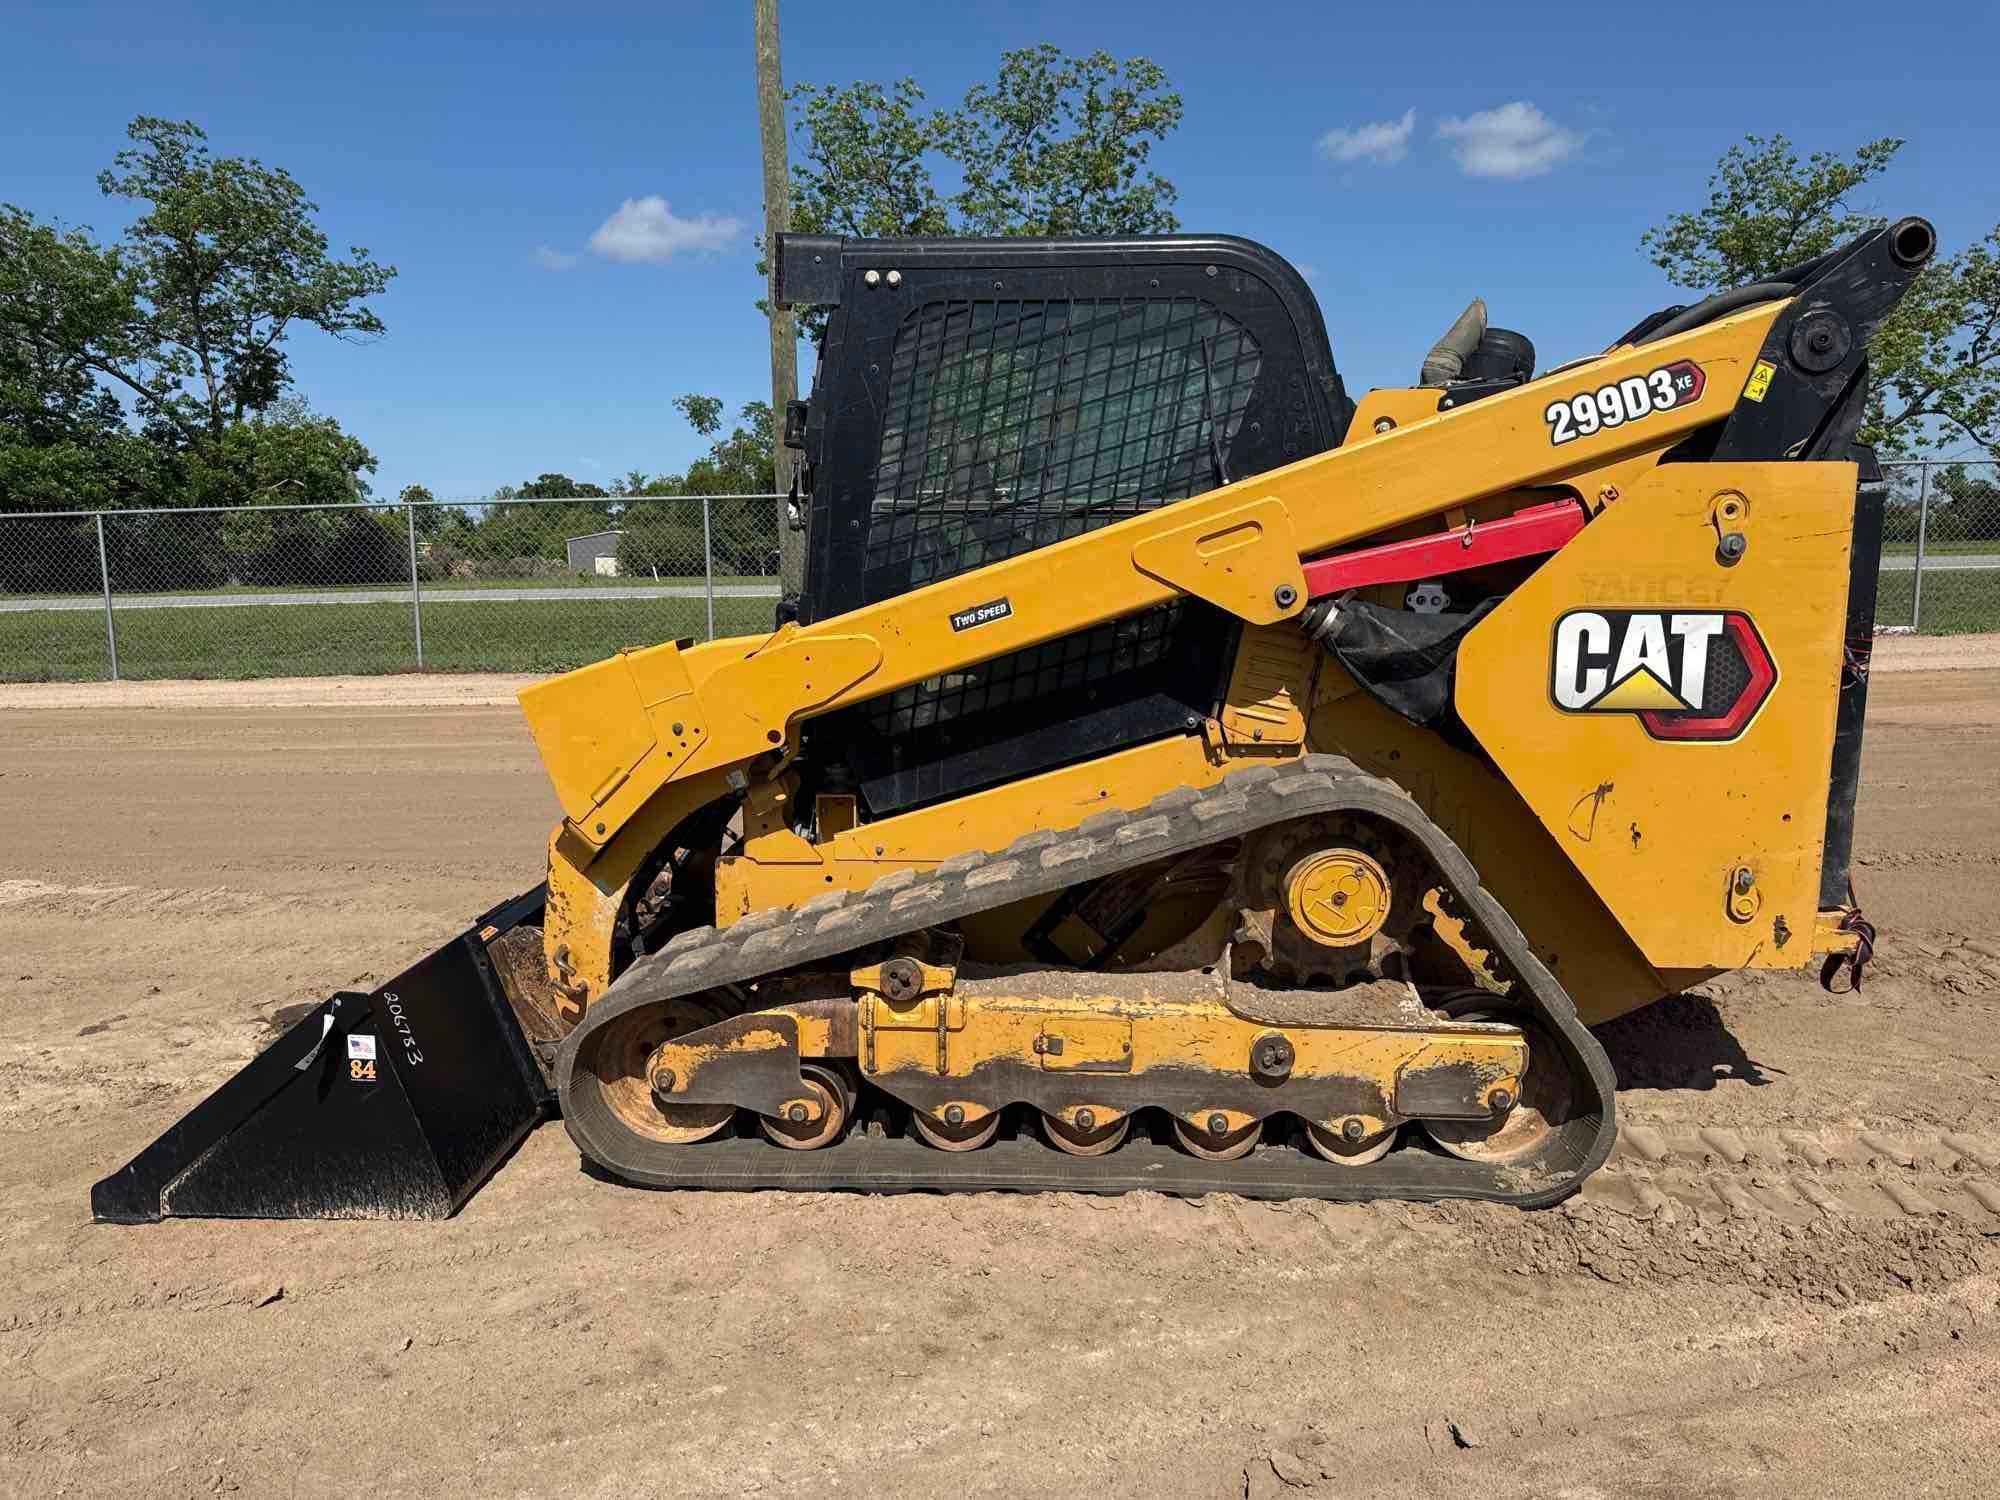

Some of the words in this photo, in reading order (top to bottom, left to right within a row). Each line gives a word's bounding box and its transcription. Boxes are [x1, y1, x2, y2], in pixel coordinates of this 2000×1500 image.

[1546, 369, 1677, 444] 299D3
[1676, 375, 1693, 392] XE
[1555, 612, 1724, 710] CAT
[383, 991, 424, 1066] 206783
[350, 1059, 376, 1079] 84
